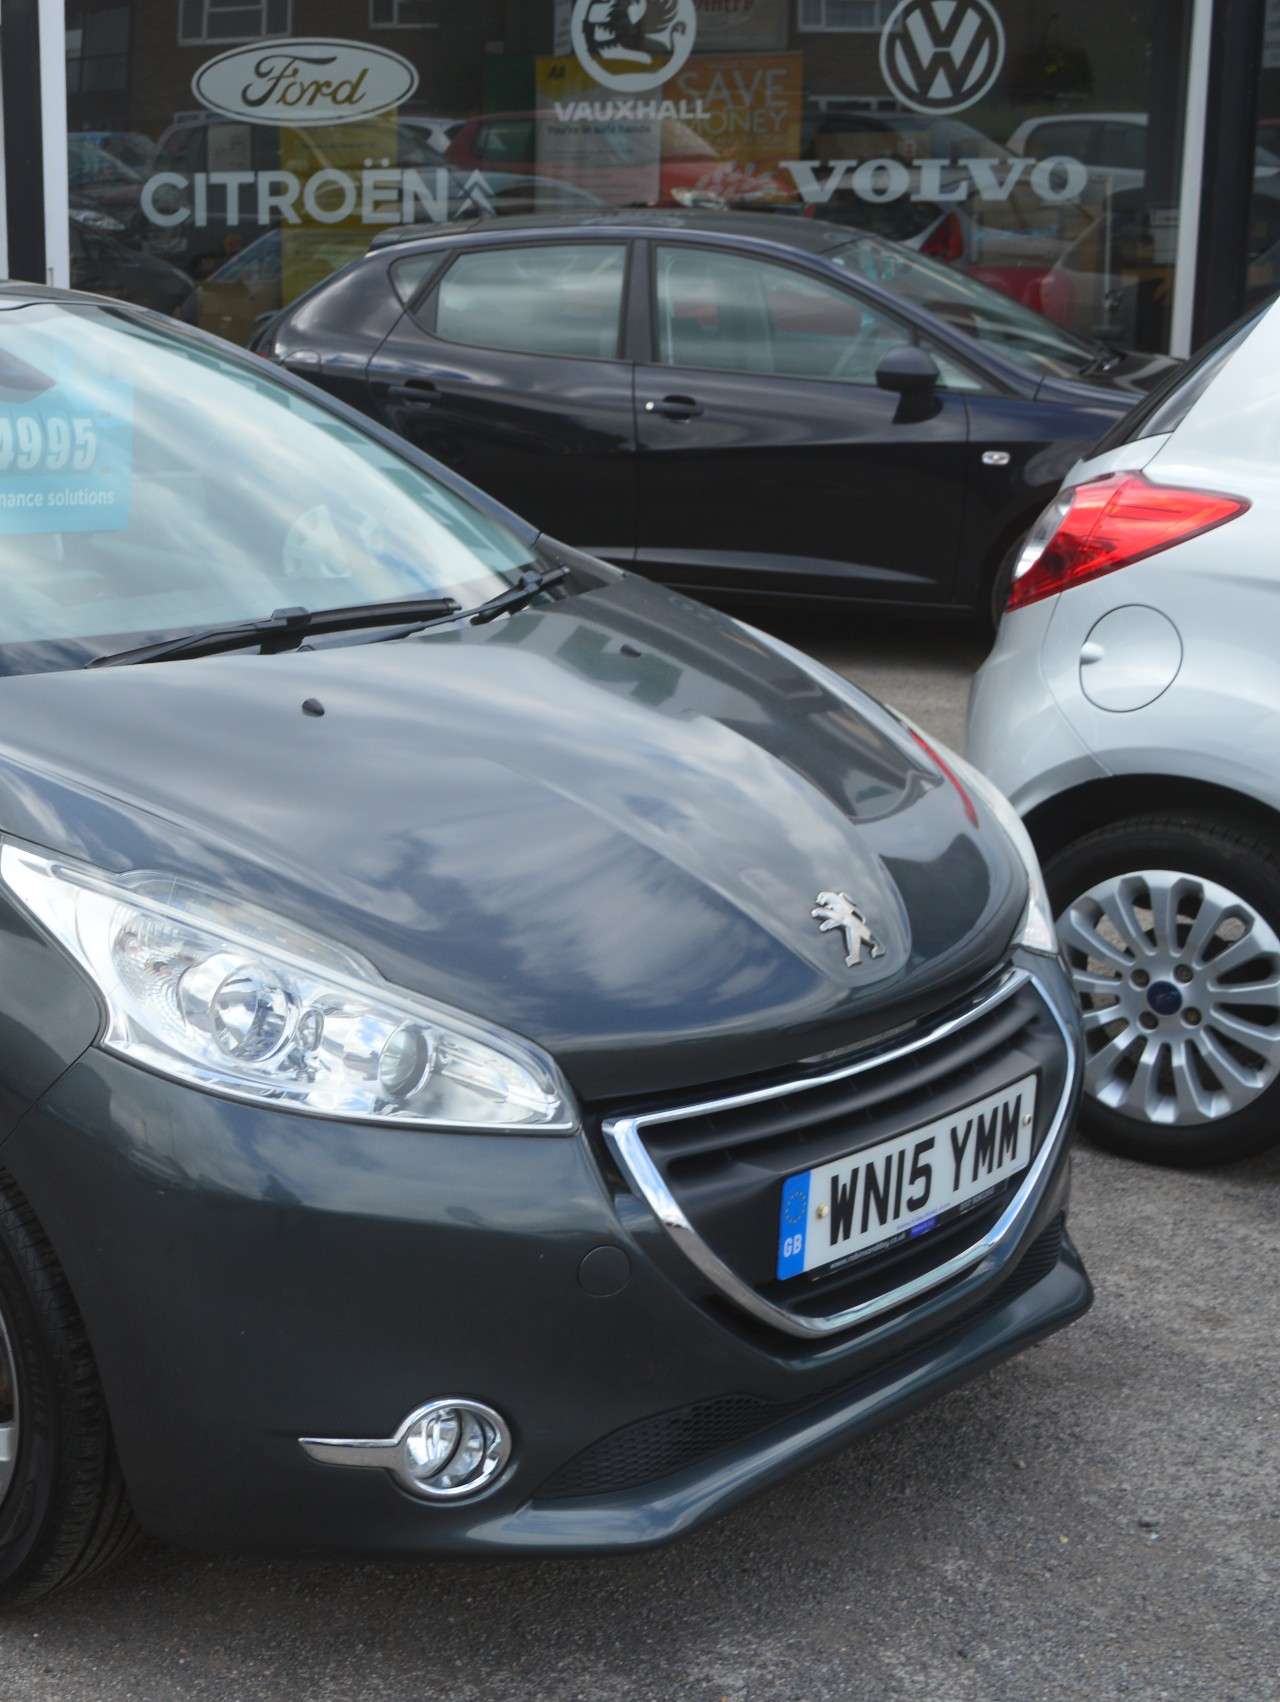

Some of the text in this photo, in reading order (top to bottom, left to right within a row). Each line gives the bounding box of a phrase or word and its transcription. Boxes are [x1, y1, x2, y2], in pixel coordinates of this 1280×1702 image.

[240, 53, 370, 108] Ford
[676, 67, 788, 109] SAVE
[553, 98, 711, 122] VAUXHALL
[139, 157, 449, 227] CITROËN
[778, 154, 1089, 204] VOLVO
[47, 487, 116, 507] solutions
[829, 1094, 1023, 1247] WN15 YMM
[783, 1233, 803, 1259] GB
